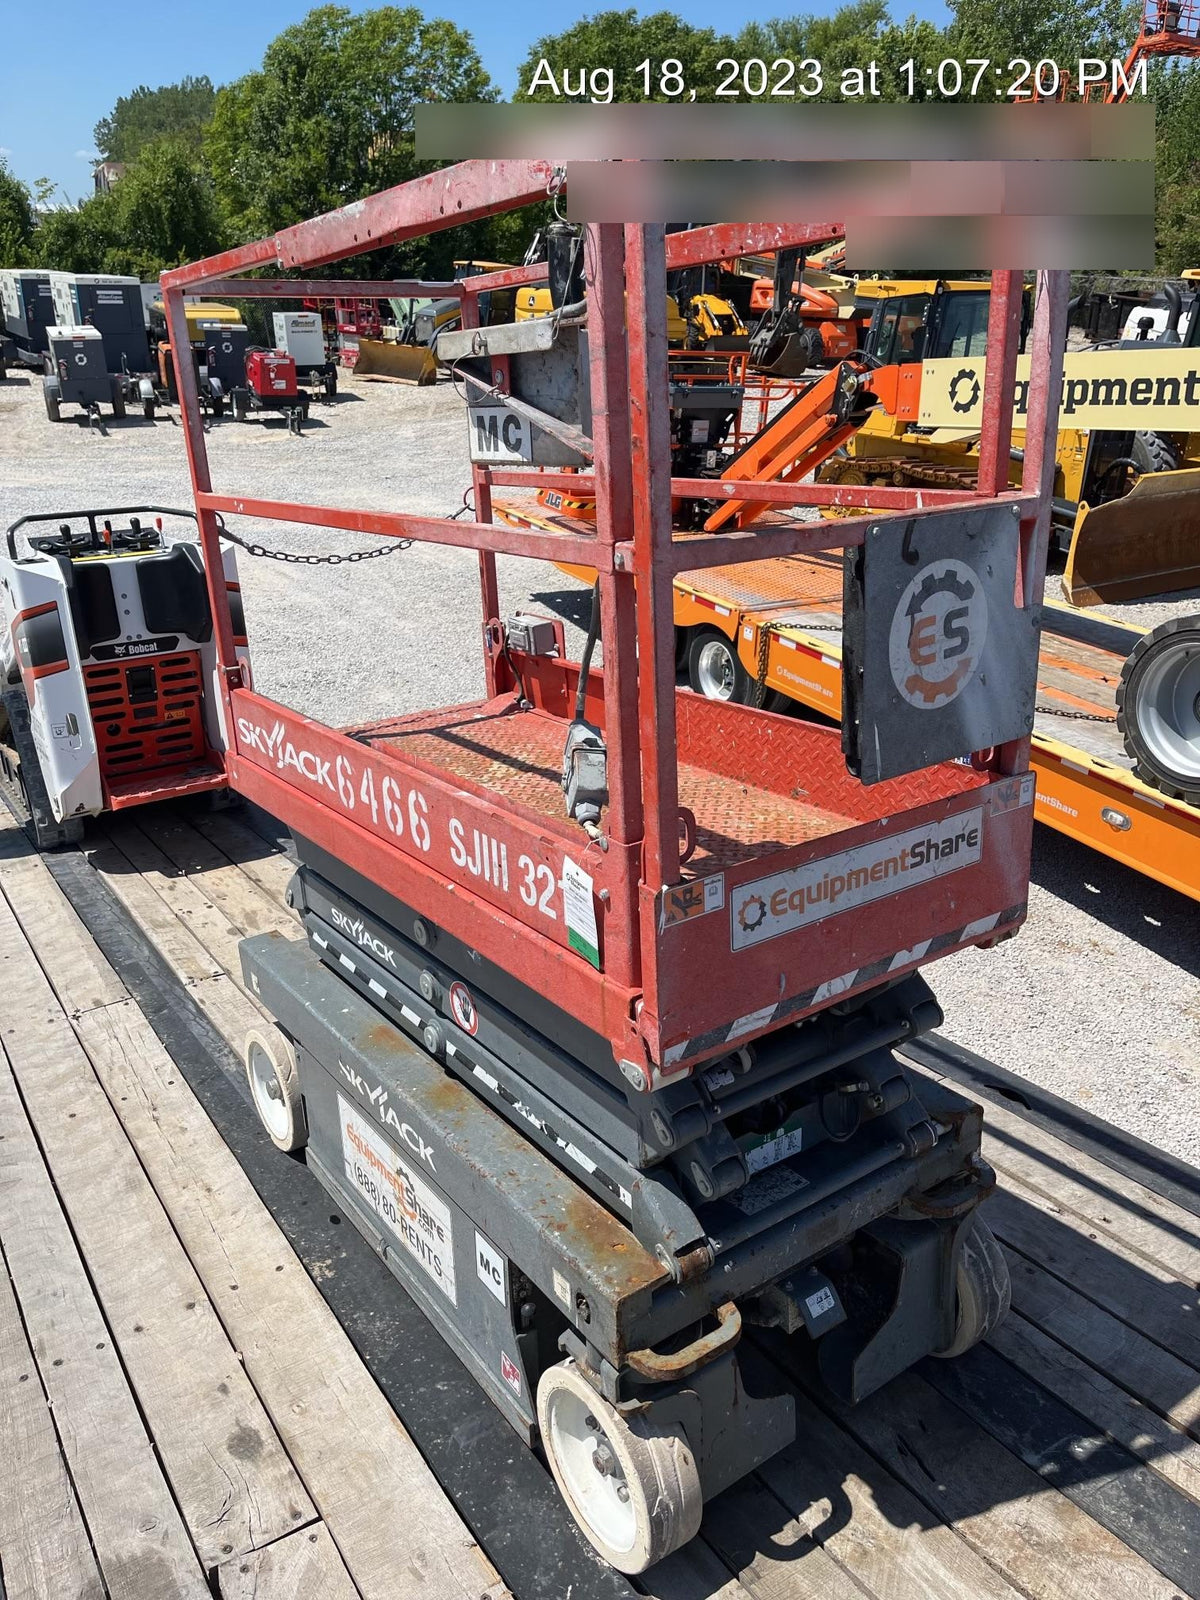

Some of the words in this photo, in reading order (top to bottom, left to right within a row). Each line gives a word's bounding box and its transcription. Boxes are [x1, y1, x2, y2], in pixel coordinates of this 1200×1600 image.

[476, 414, 522, 453] MC
[545, 492, 562, 508] JLG
[128, 642, 158, 655] Bobcat
[910, 605, 970, 667] ES
[237, 717, 336, 792] SKYJACK
[336, 754, 431, 852] 6466
[769, 827, 979, 917] EquipmentShare
[331, 907, 398, 969] SKYJACK
[338, 1059, 438, 1174] SKYJACK
[382, 1195, 443, 1278] 80-RENTS
[479, 1251, 502, 1286] MC
